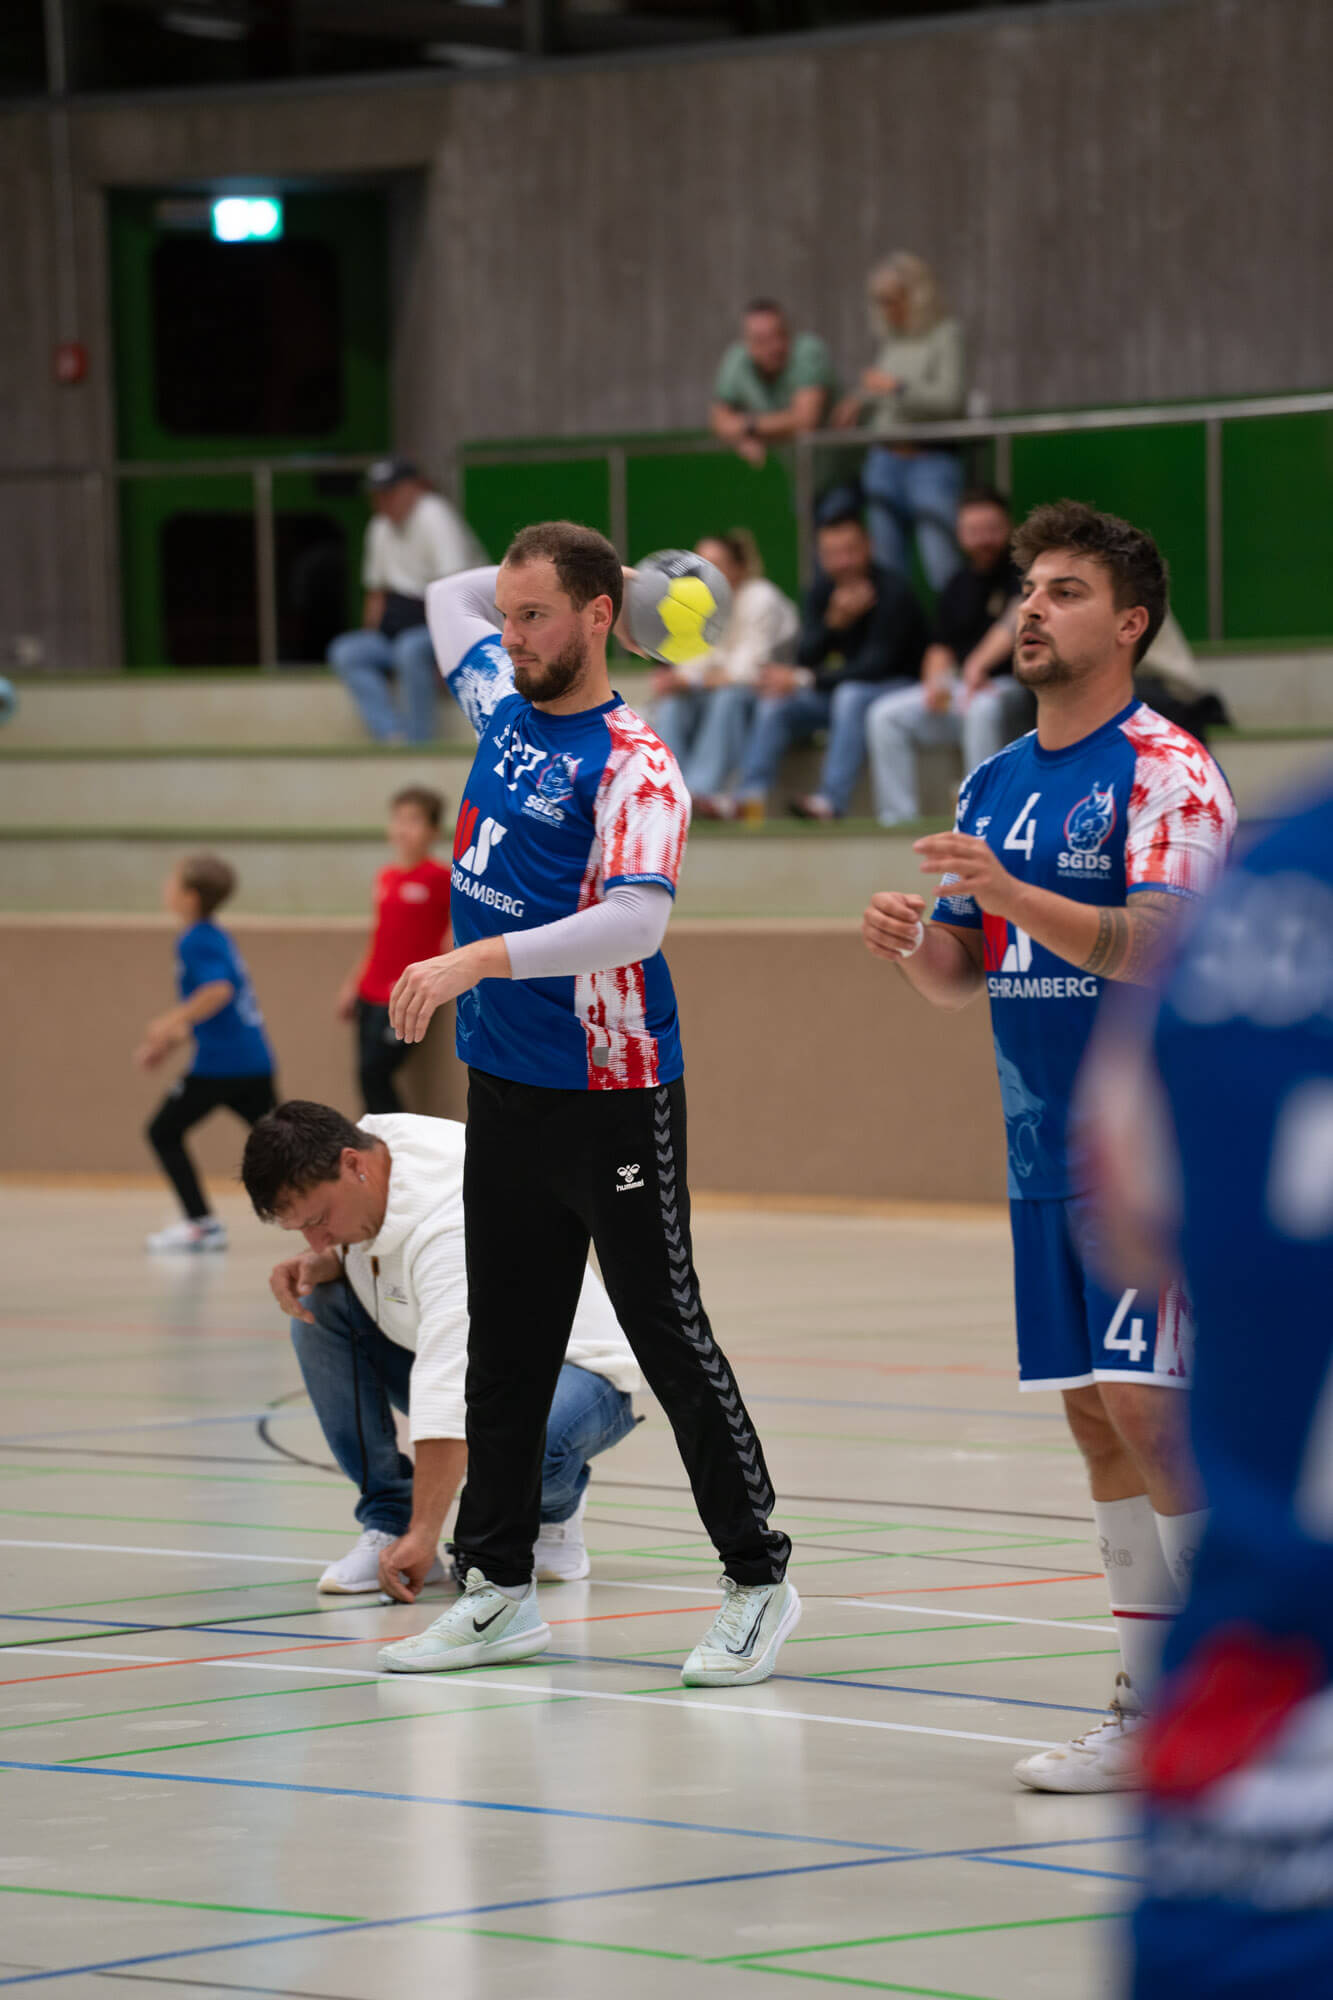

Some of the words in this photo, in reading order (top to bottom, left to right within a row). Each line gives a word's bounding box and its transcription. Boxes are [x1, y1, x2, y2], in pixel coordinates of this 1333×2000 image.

[1003, 792, 1041, 861] 4
[1057, 852, 1112, 870] SGDS
[451, 863, 525, 918] HRAMBERG
[616, 1178, 644, 1192] hummel
[1103, 1288, 1147, 1362] 4
